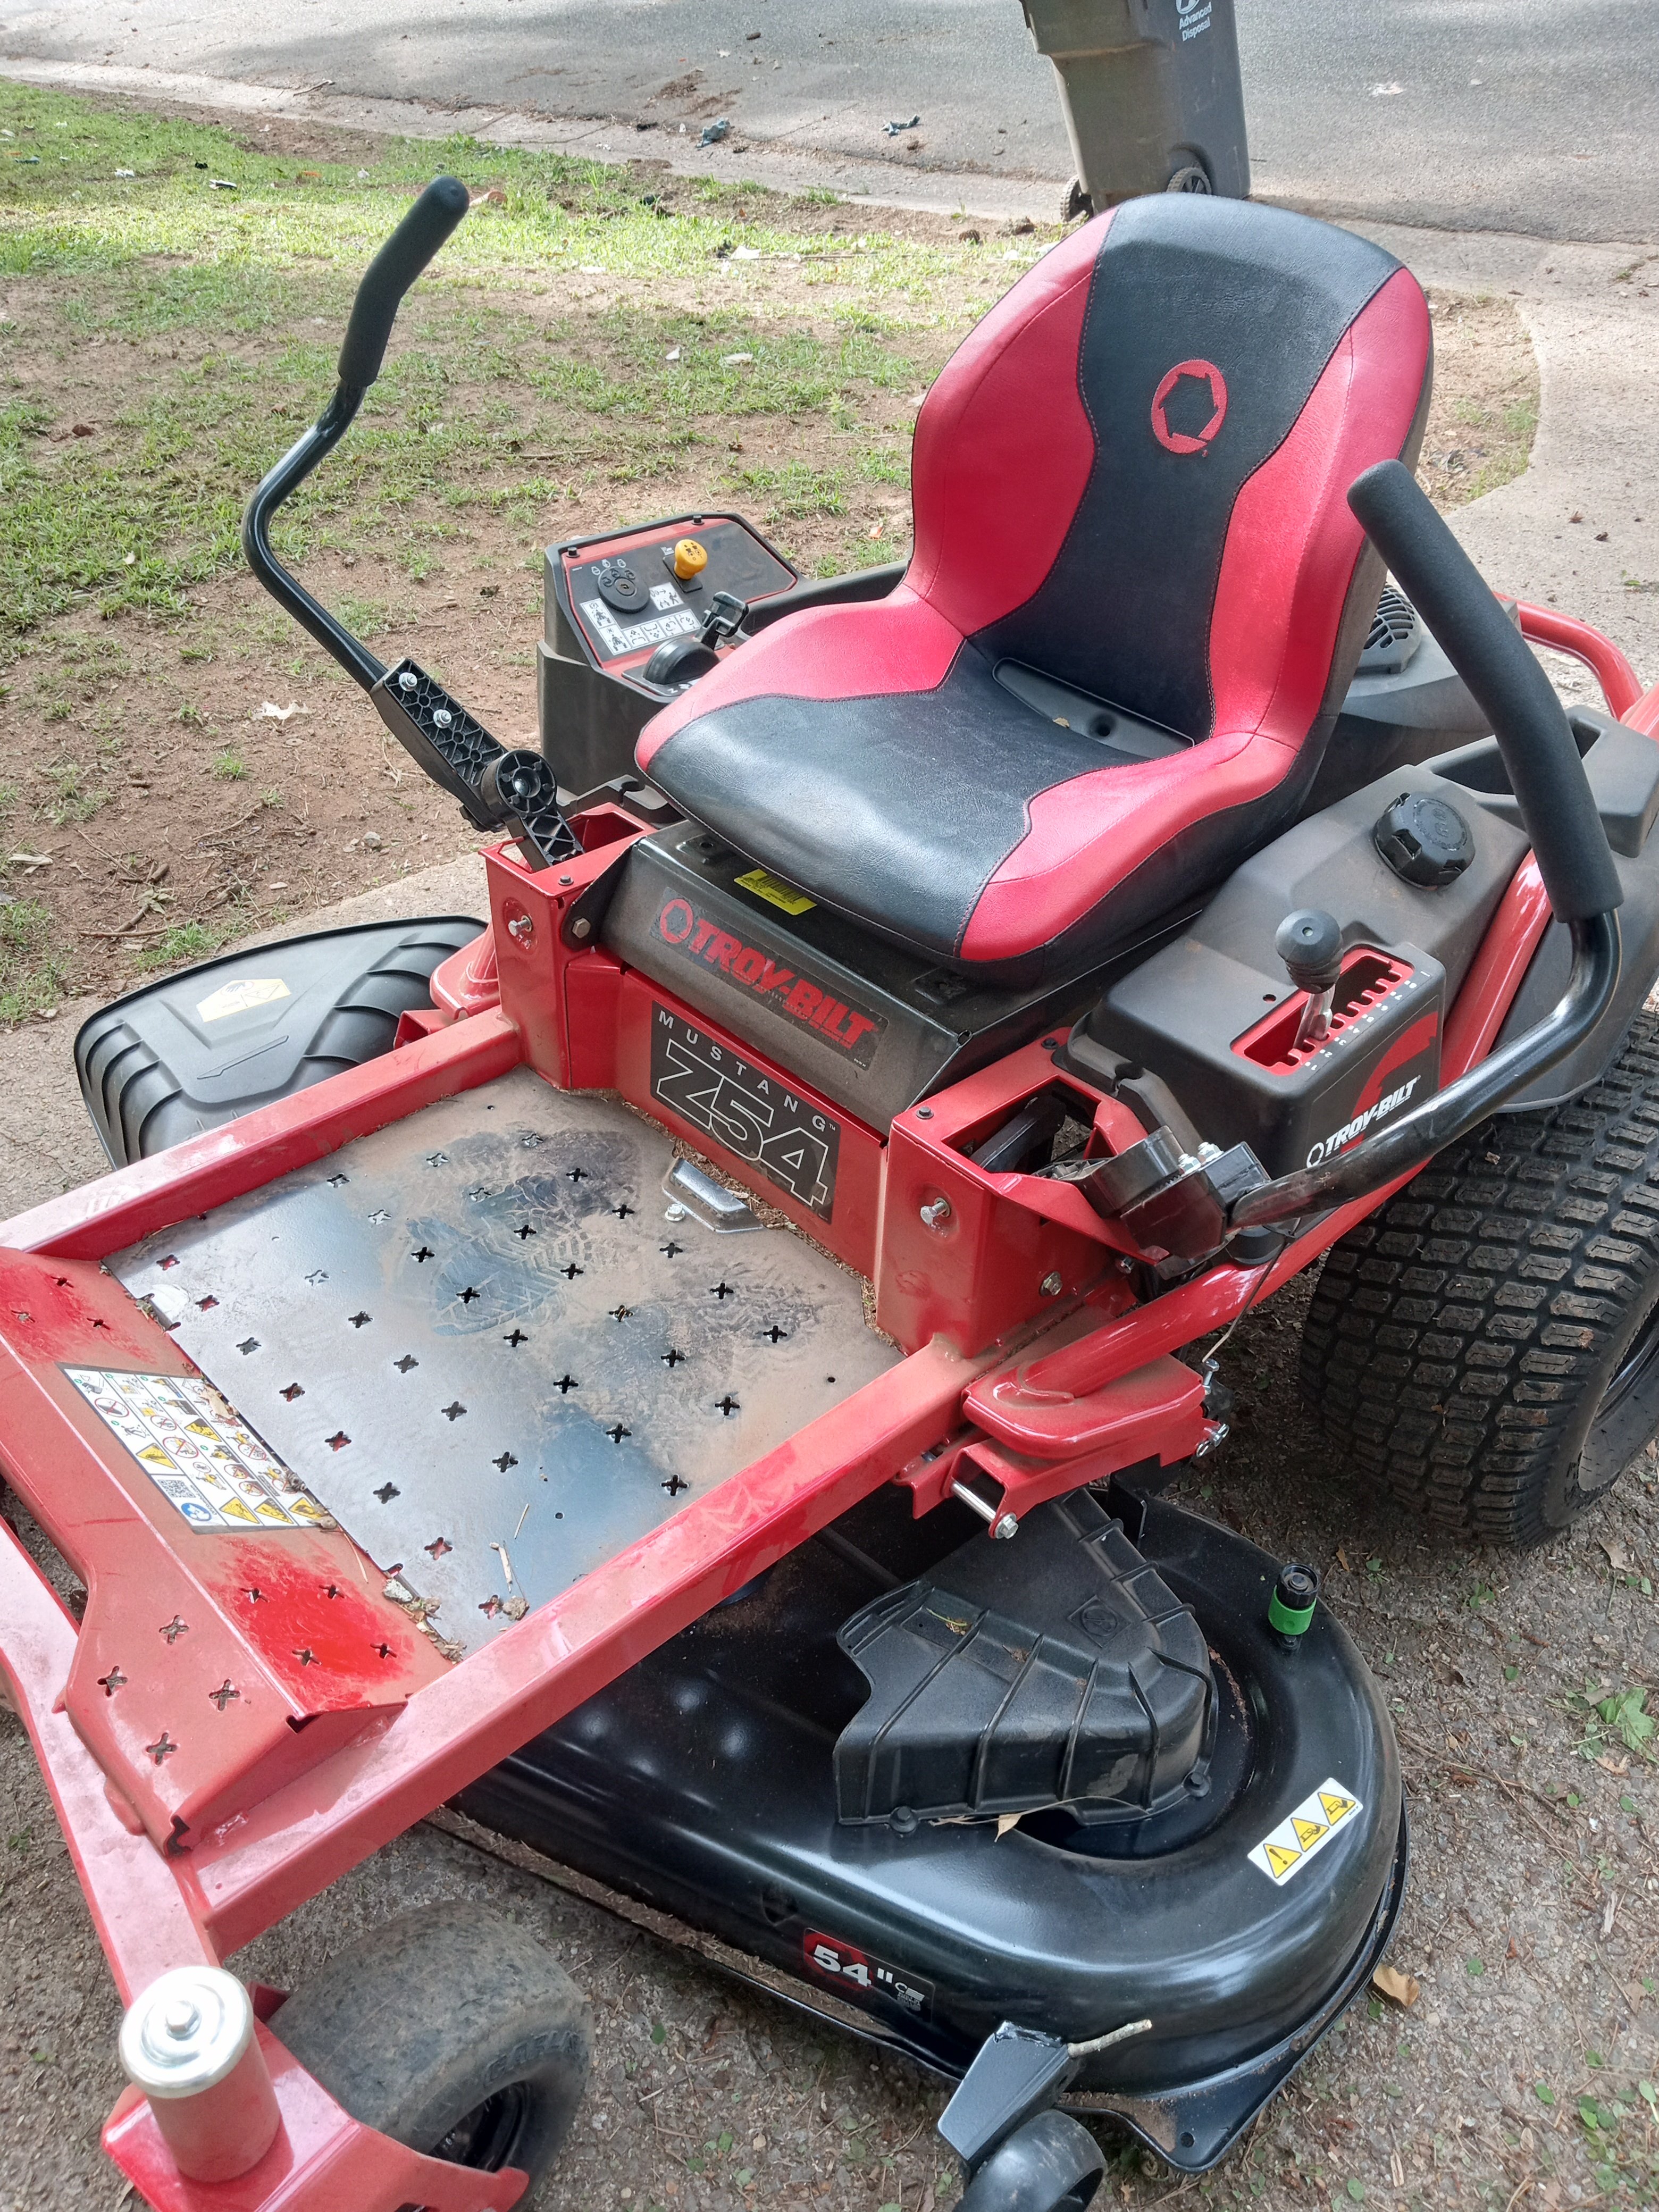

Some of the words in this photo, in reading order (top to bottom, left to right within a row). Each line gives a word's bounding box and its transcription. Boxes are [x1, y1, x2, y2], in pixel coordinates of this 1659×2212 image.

[1179, 1, 1212, 30] Advanced
[1182, 16, 1211, 41] Disposal
[656, 1038, 829, 1207] Z54
